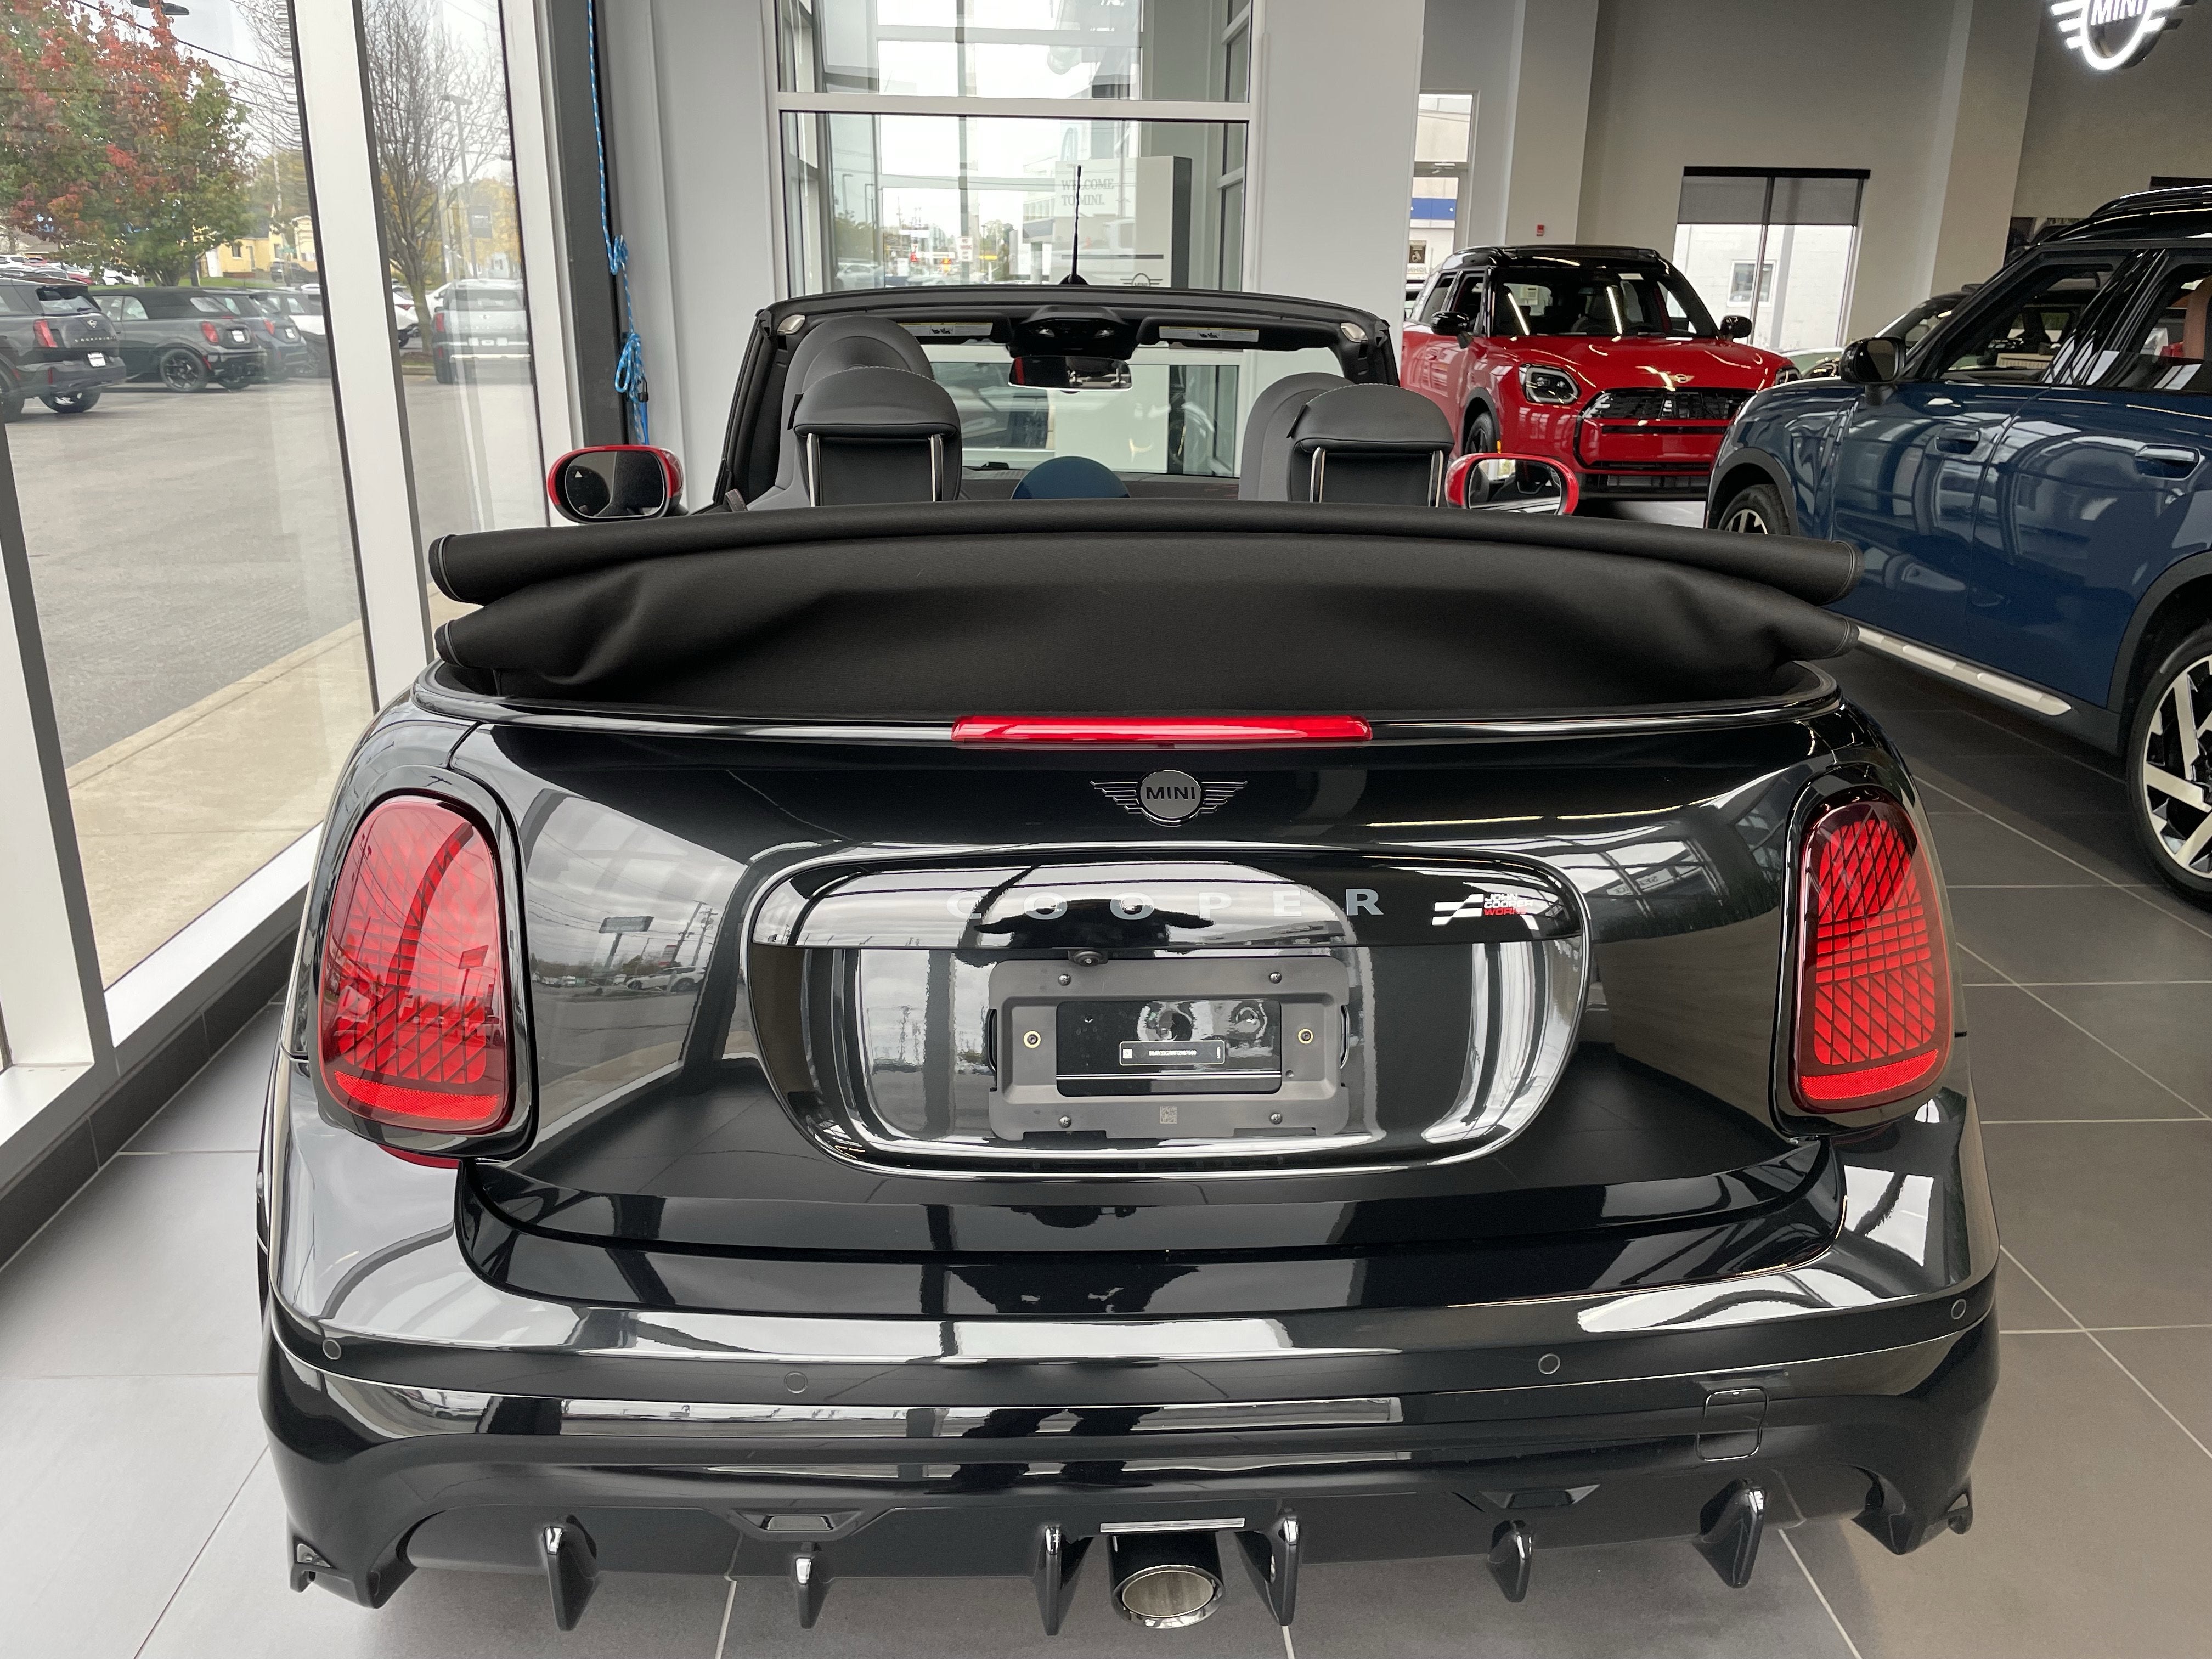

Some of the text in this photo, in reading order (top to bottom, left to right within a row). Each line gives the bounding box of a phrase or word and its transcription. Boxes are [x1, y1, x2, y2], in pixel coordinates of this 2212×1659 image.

[2090, 0, 2144, 25] MINI
[1061, 178, 1114, 191] WECOME
[1146, 786, 1195, 800] MINI
[1485, 893, 1518, 901] JOHN
[946, 888, 1384, 920] COOPER
[1483, 899, 1533, 909] COOPER
[1483, 907, 1527, 916] WORKS
